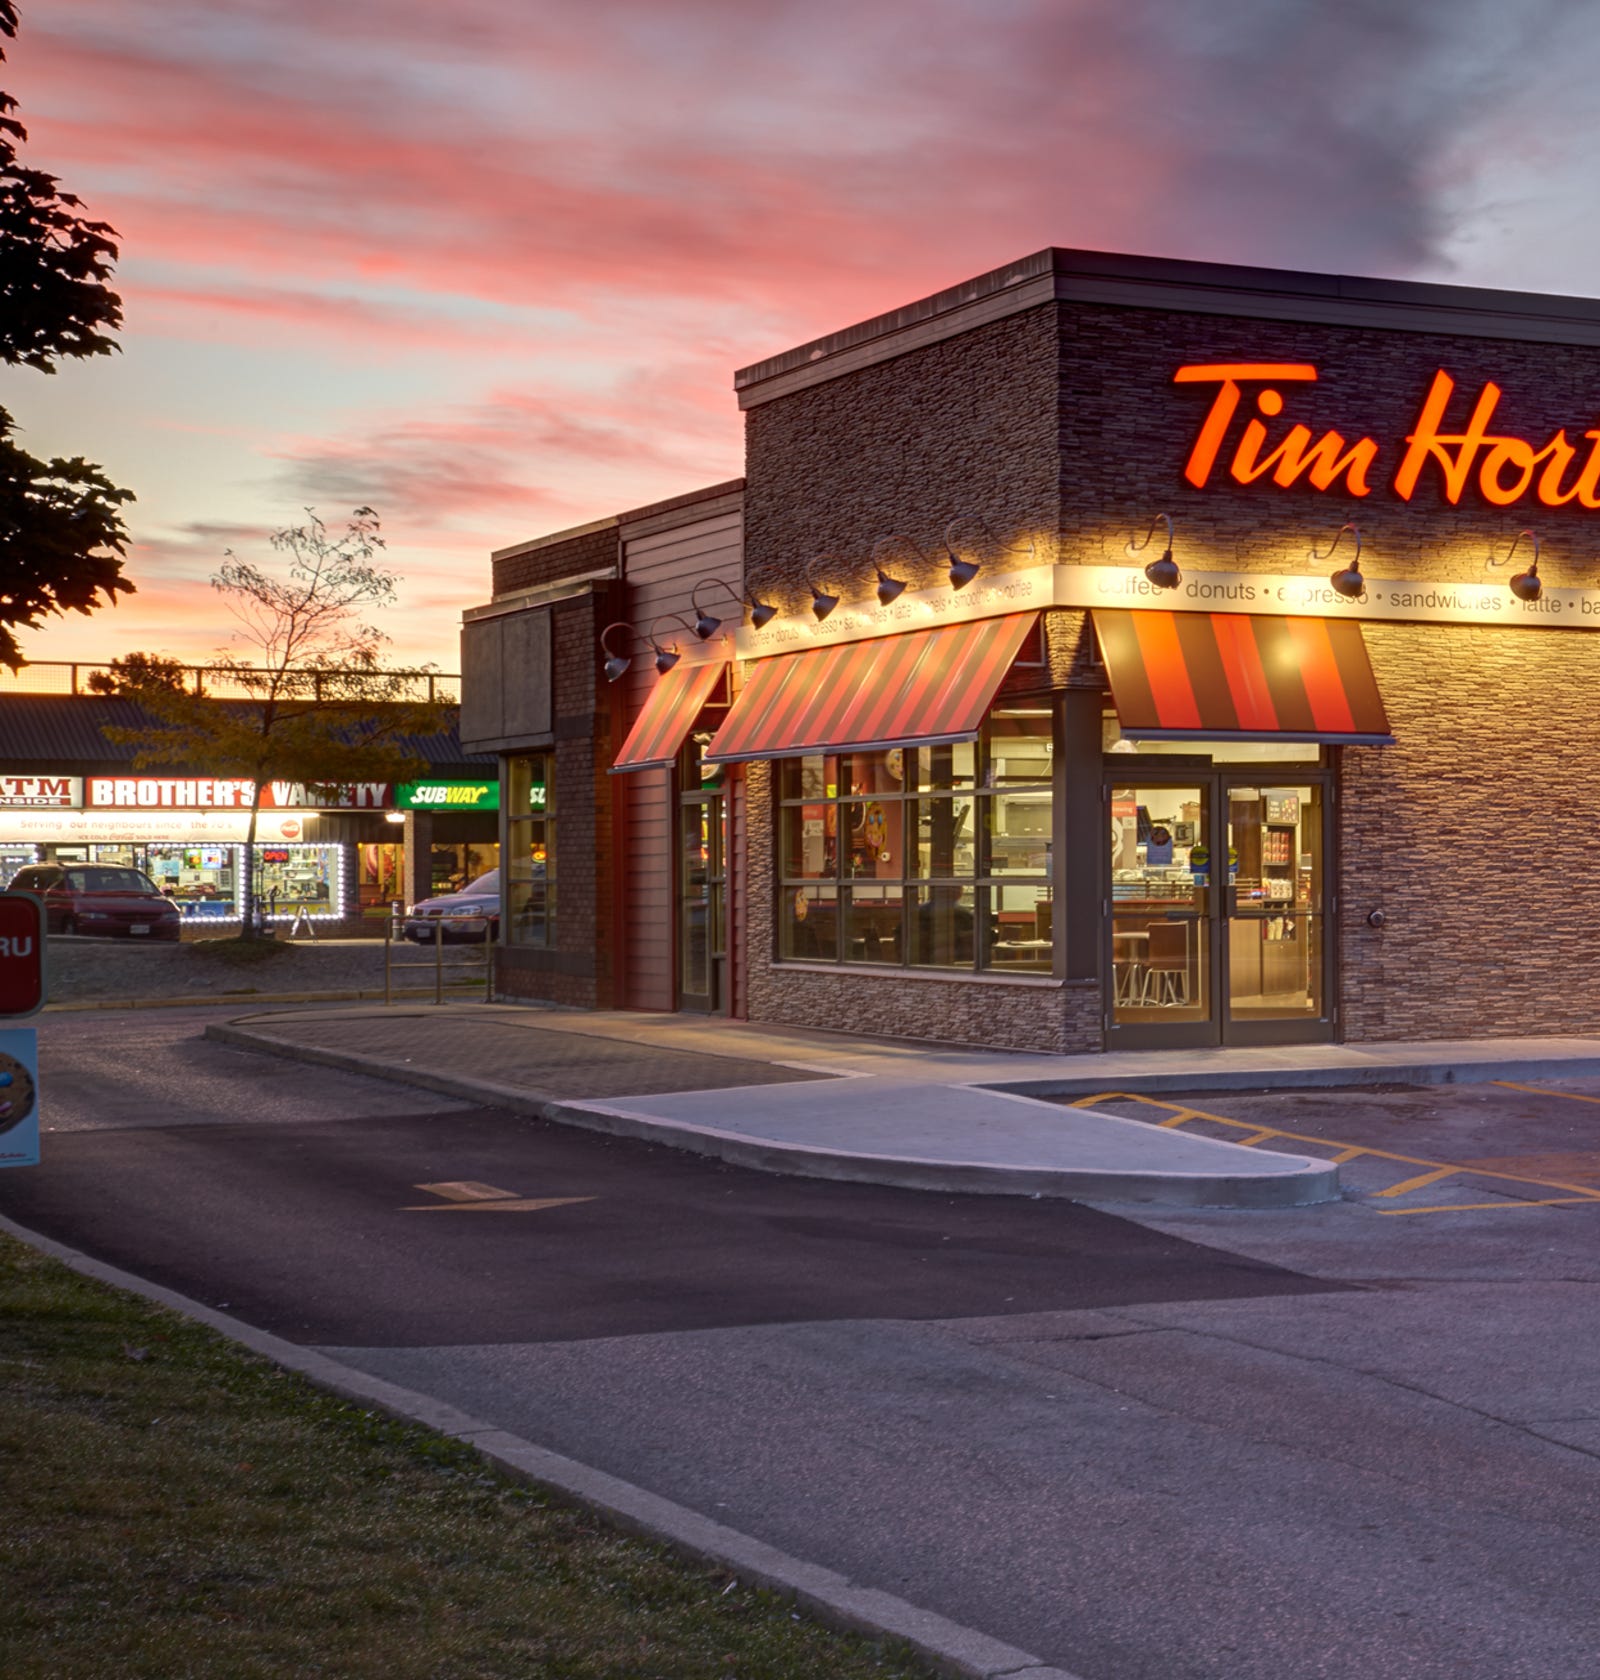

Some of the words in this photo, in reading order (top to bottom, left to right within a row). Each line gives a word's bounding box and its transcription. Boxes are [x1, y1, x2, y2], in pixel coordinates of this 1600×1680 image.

[1174, 363, 1378, 497] Tim
[1186, 579, 1256, 600] donuts
[1277, 584, 1369, 607] epresso
[0, 778, 71, 796] TM
[92, 780, 256, 807] BROTHER'S
[271, 781, 387, 807] VARETY
[410, 786, 488, 804] SUBWAY
[191, 820, 207, 829] the
[264, 850, 288, 861] OPEN
